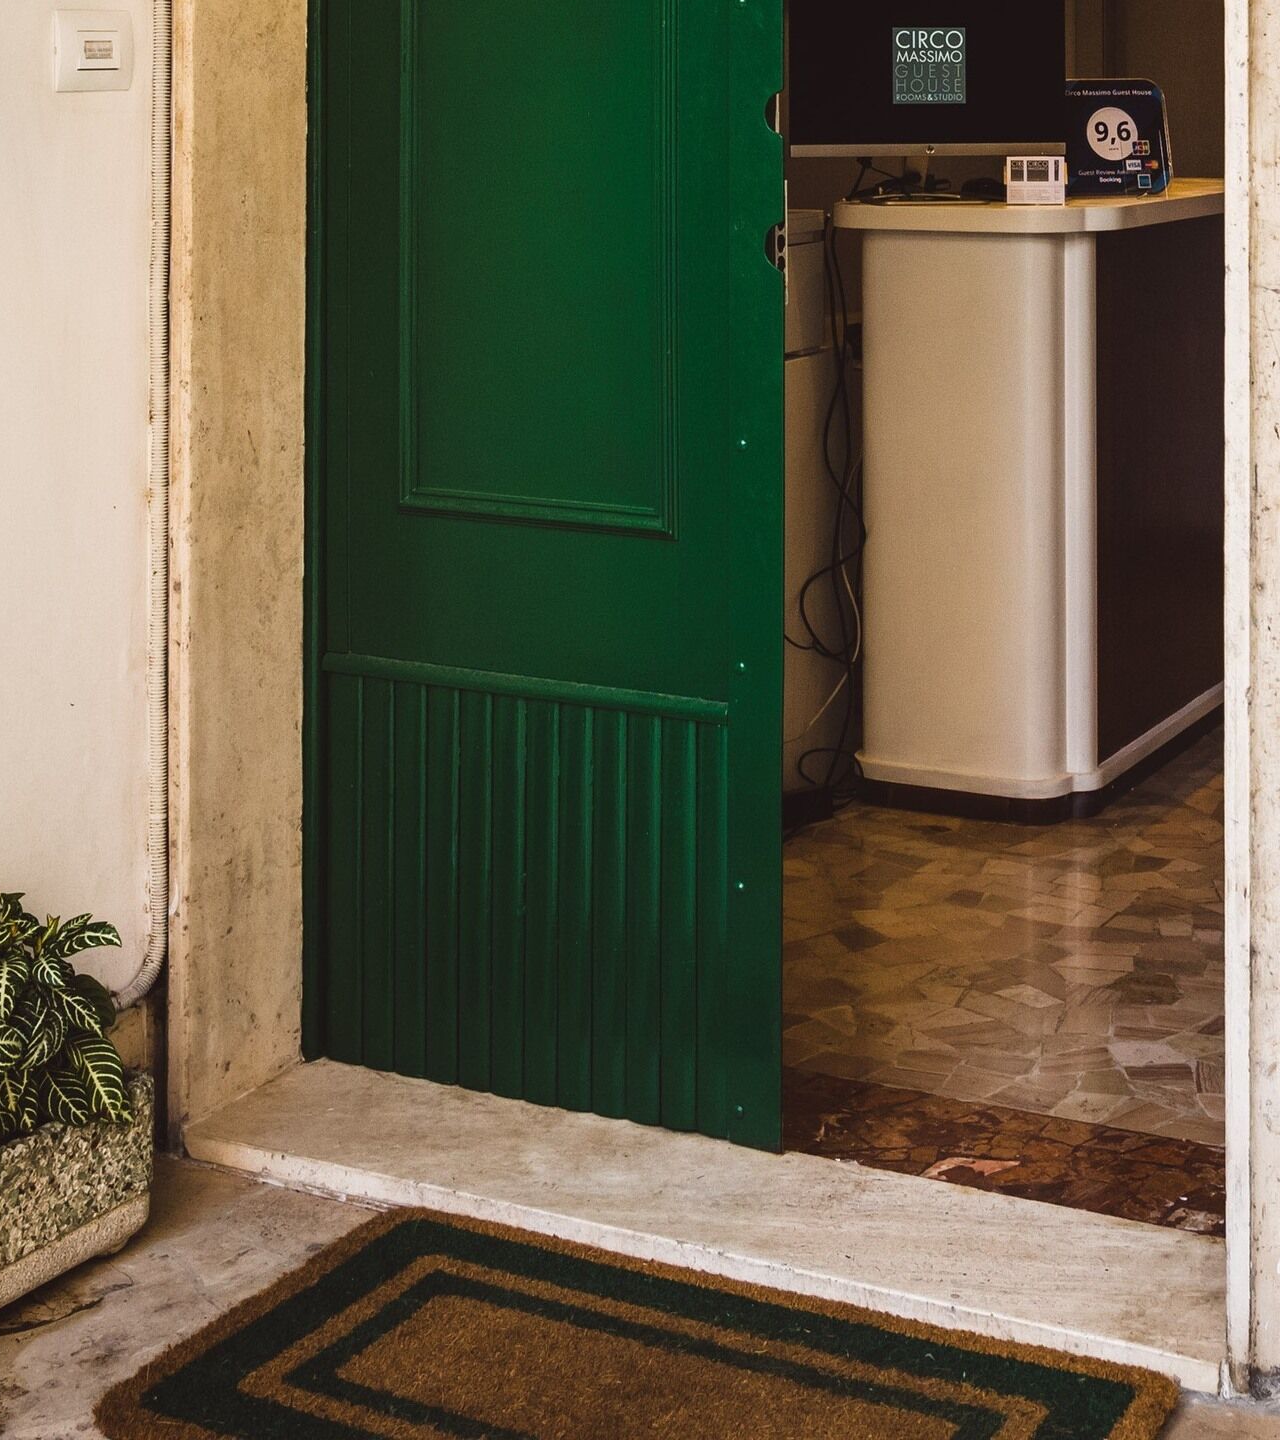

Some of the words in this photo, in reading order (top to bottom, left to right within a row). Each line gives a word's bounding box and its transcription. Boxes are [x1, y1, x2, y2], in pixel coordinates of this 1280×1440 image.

[895, 30, 964, 49] CIRCO
[896, 50, 963, 63] MASSIMO
[895, 63, 962, 78] GUEST
[895, 78, 961, 93] HOUSE
[1094, 121, 1131, 145] 9,6
[1099, 176, 1122, 184] Booking
